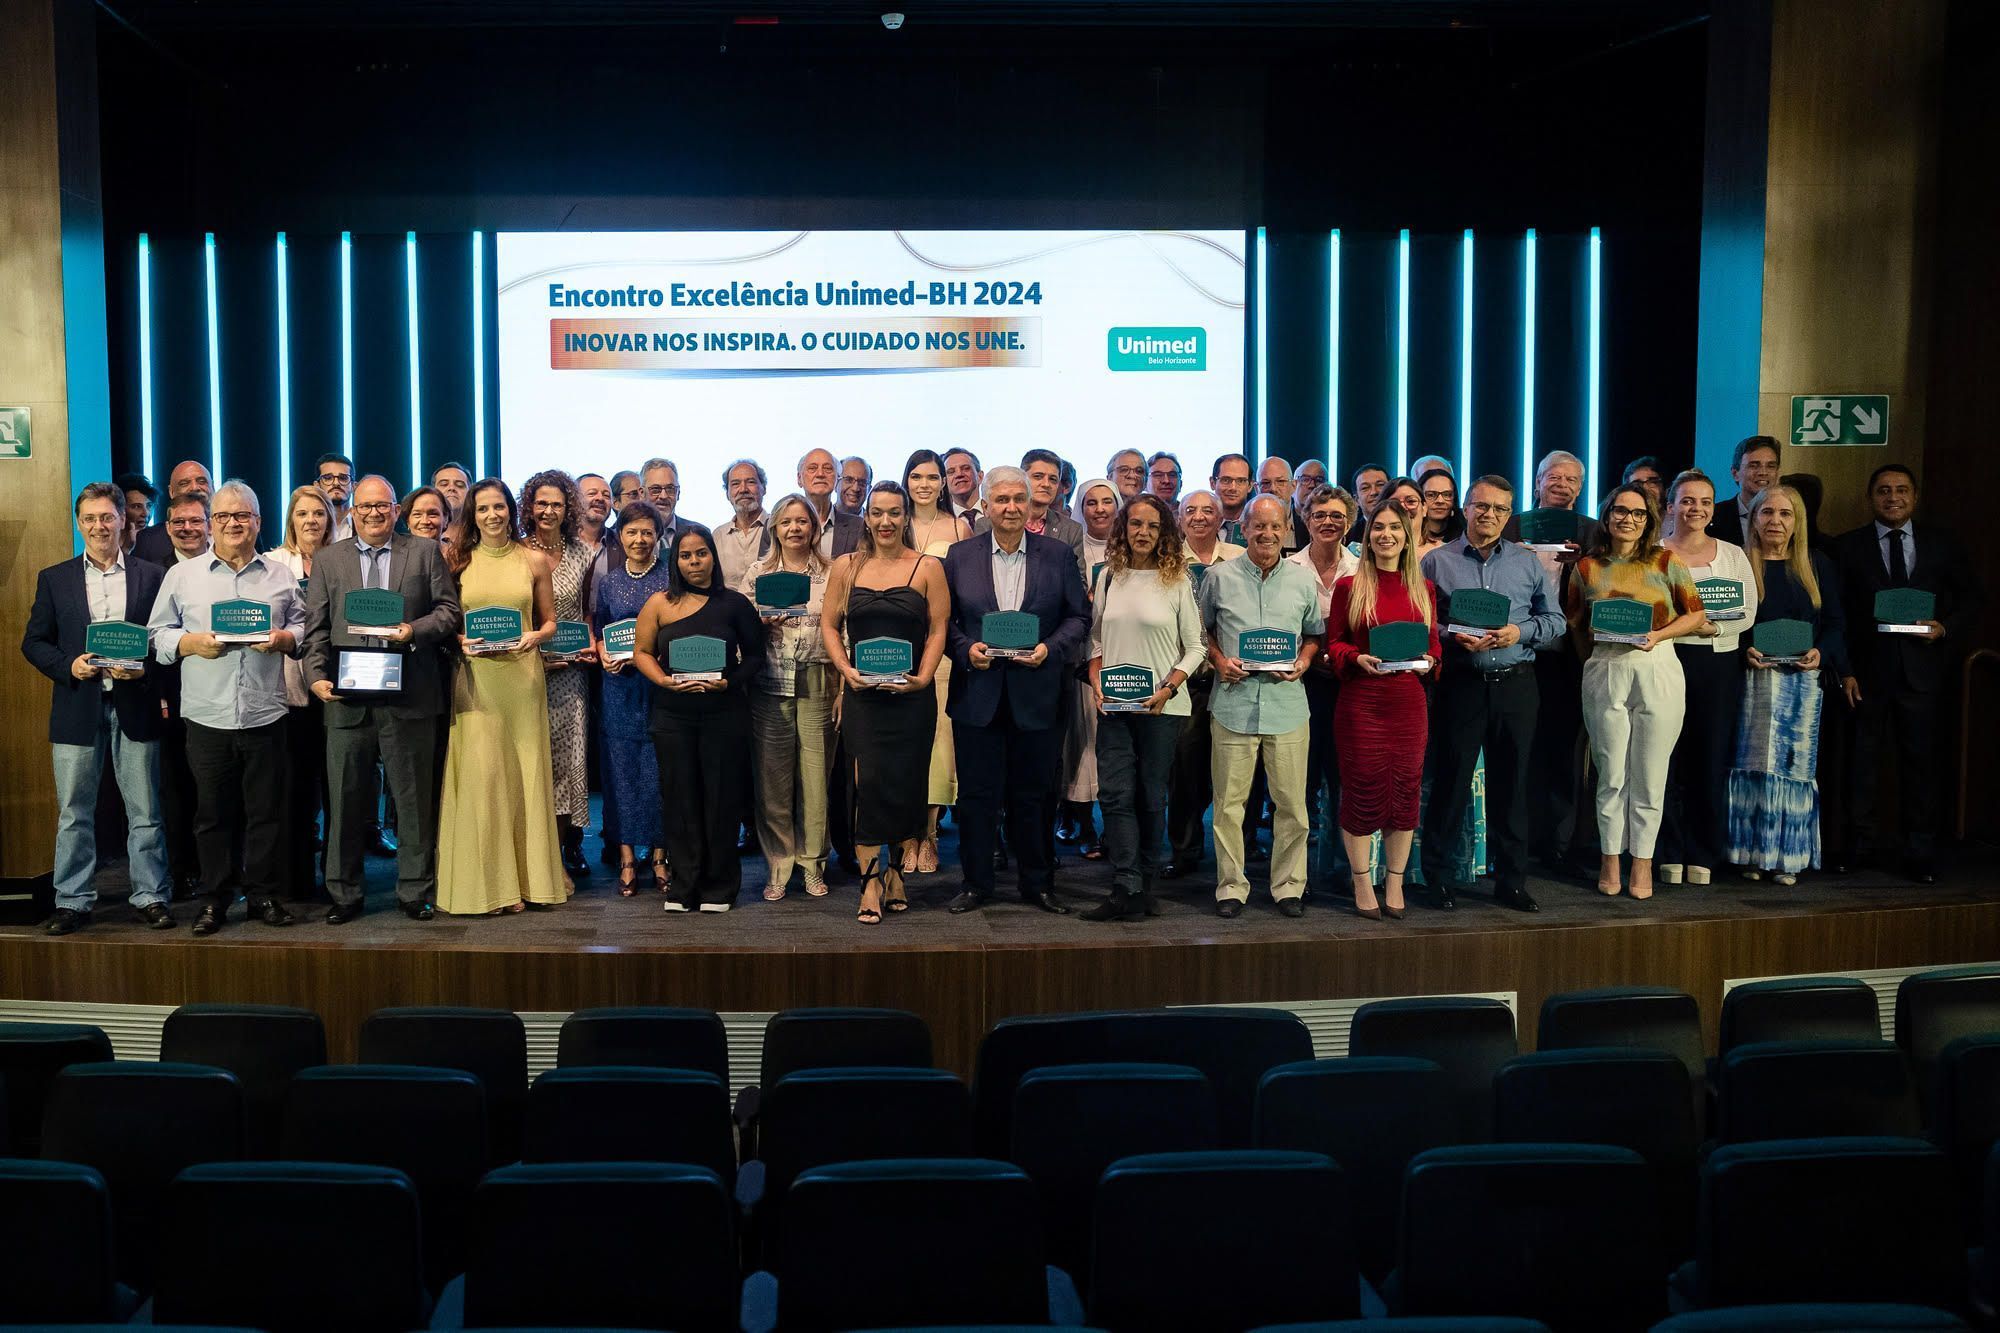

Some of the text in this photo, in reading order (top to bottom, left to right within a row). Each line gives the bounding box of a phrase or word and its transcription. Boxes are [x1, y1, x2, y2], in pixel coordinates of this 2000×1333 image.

[549, 280, 1043, 307] Encontro Excelência Unimed-BH 2024
[564, 332, 1025, 352] INOVAR NOS INSPIRA. O CUIDADO NOS UNE.
[1117, 336, 1197, 355] Unimed
[1148, 356, 1197, 365] Belo Horizonte
[470, 622, 517, 630] ASSISTENCIAL
[96, 631, 140, 640] EXCELÊNCIA
[92, 637, 143, 647] ASSISTENCIAL
